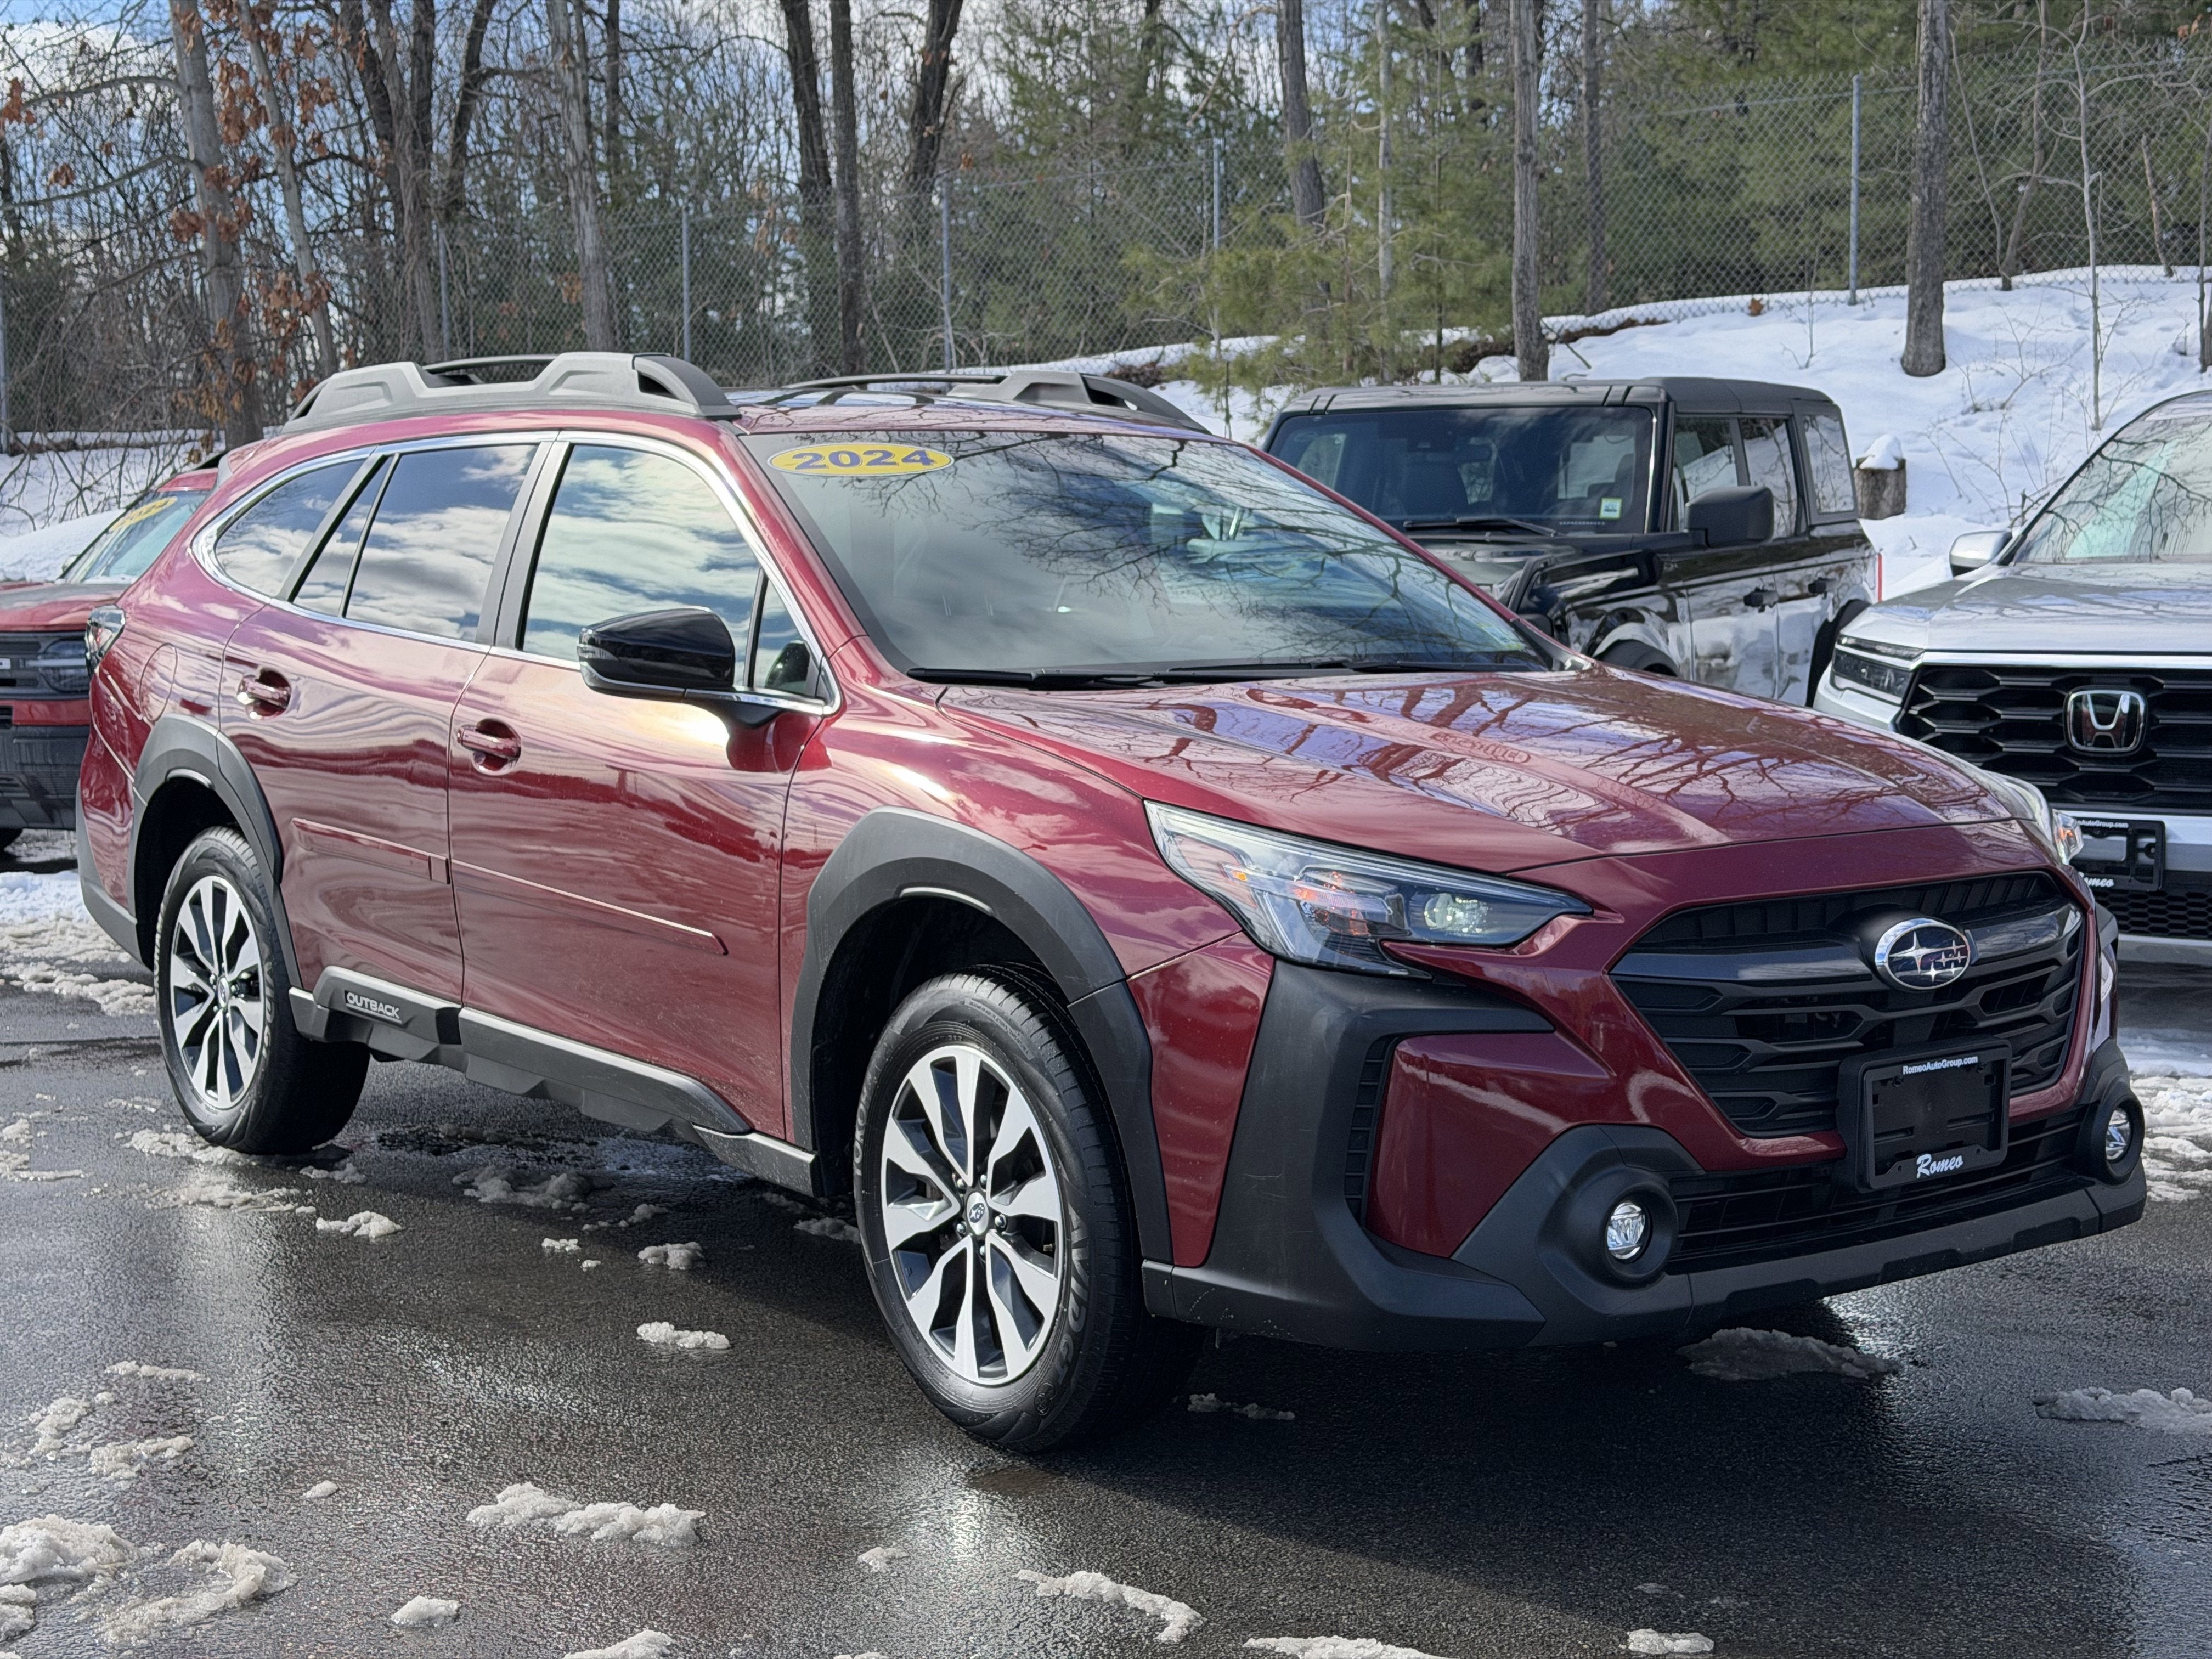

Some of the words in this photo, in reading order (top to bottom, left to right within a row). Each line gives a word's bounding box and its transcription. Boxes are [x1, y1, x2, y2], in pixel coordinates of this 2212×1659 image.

[792, 449, 935, 470] 2024
[347, 992, 400, 1019] OUTBACK
[1903, 1056, 1978, 1075] RomeoAutoGroup.com
[1916, 1153, 1963, 1178] Romeo
